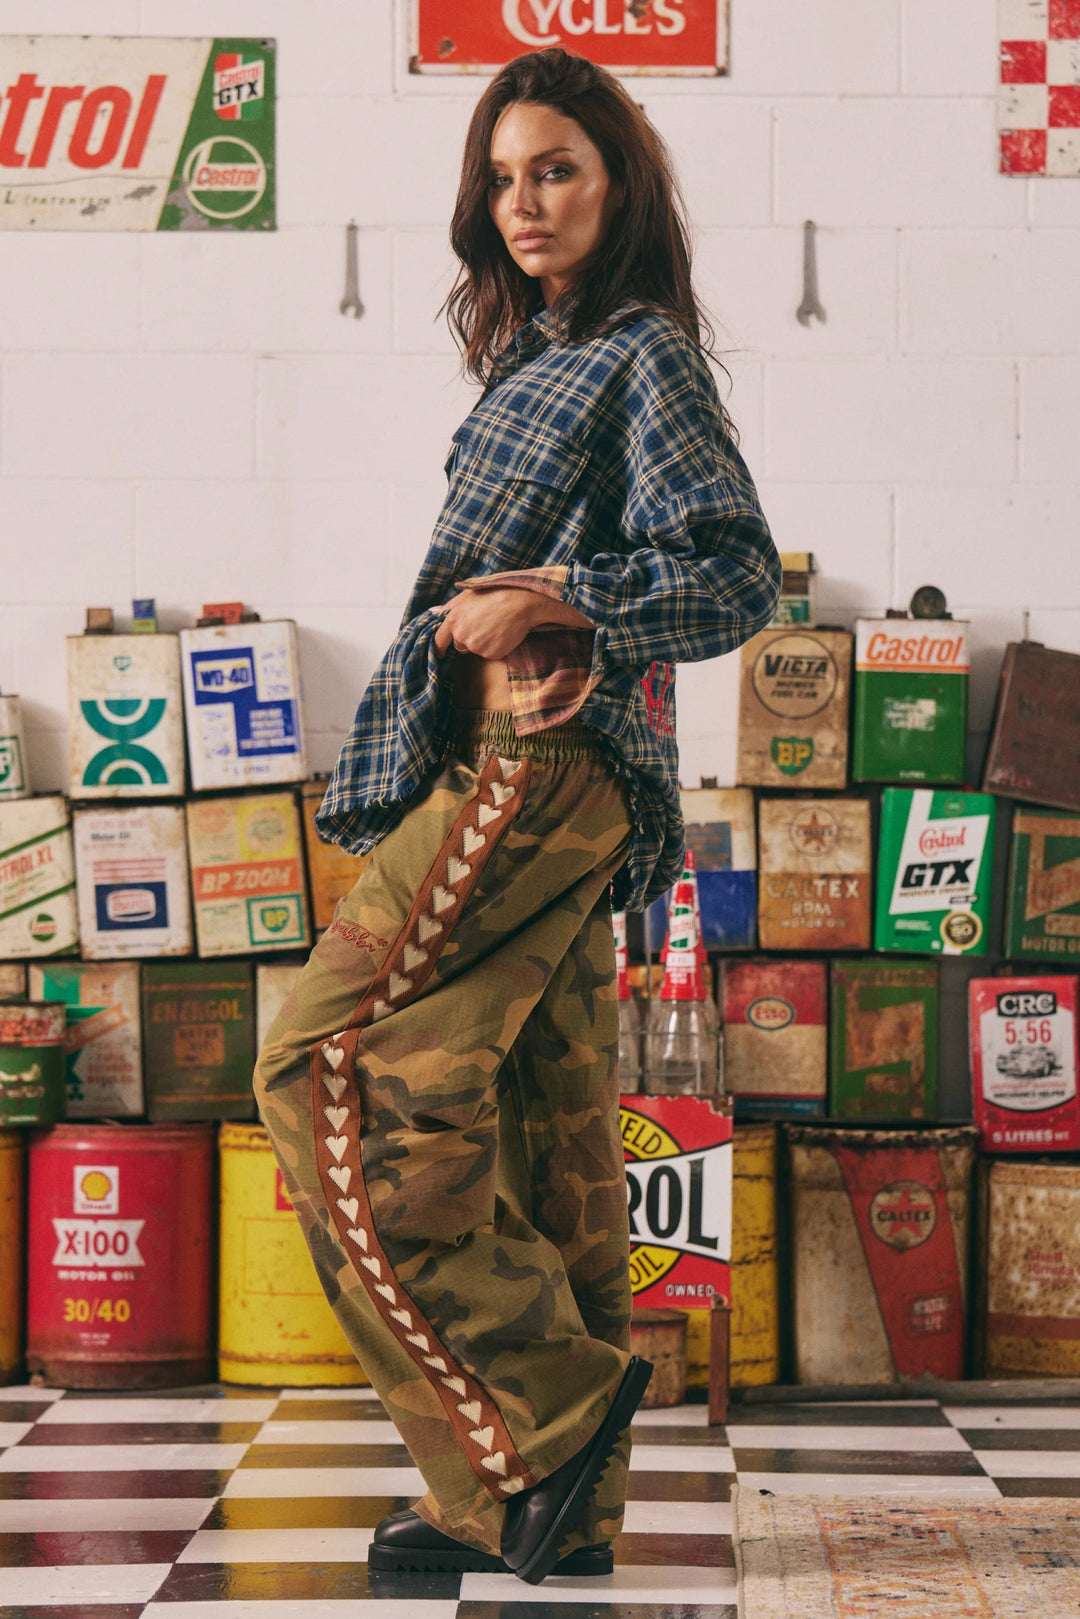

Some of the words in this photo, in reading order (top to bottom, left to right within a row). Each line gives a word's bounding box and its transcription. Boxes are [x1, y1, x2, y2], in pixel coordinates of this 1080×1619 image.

[502, 0, 687, 46] CYCLES
[217, 79, 259, 107] GTX
[0, 73, 168, 169] trol
[196, 166, 260, 187] Castrol
[865, 633, 964, 663] Castrol
[200, 667, 249, 687] WD-40
[776, 742, 812, 767] BP
[918, 826, 967, 858] Castrol
[37, 845, 54, 867] XL
[202, 871, 231, 894] BP
[232, 865, 293, 891] ZOOM
[901, 859, 975, 889] GTX
[766, 878, 860, 899] CALTEX
[263, 909, 289, 928] BP
[791, 901, 831, 916] RPM
[1021, 936, 1066, 953] MOTOR
[754, 999, 788, 1021] Esso
[999, 993, 1055, 1016] CRC
[1005, 1129, 1053, 1143] LITRES
[877, 1209, 931, 1223] CALTEX
[64, 1230, 130, 1256] X-100
[58, 1270, 107, 1281] MOTOR
[111, 1270, 135, 1282] OIL
[630, 1251, 664, 1284] OIL
[665, 1284, 715, 1297] OWNED
[63, 1298, 131, 1323] 30/40
